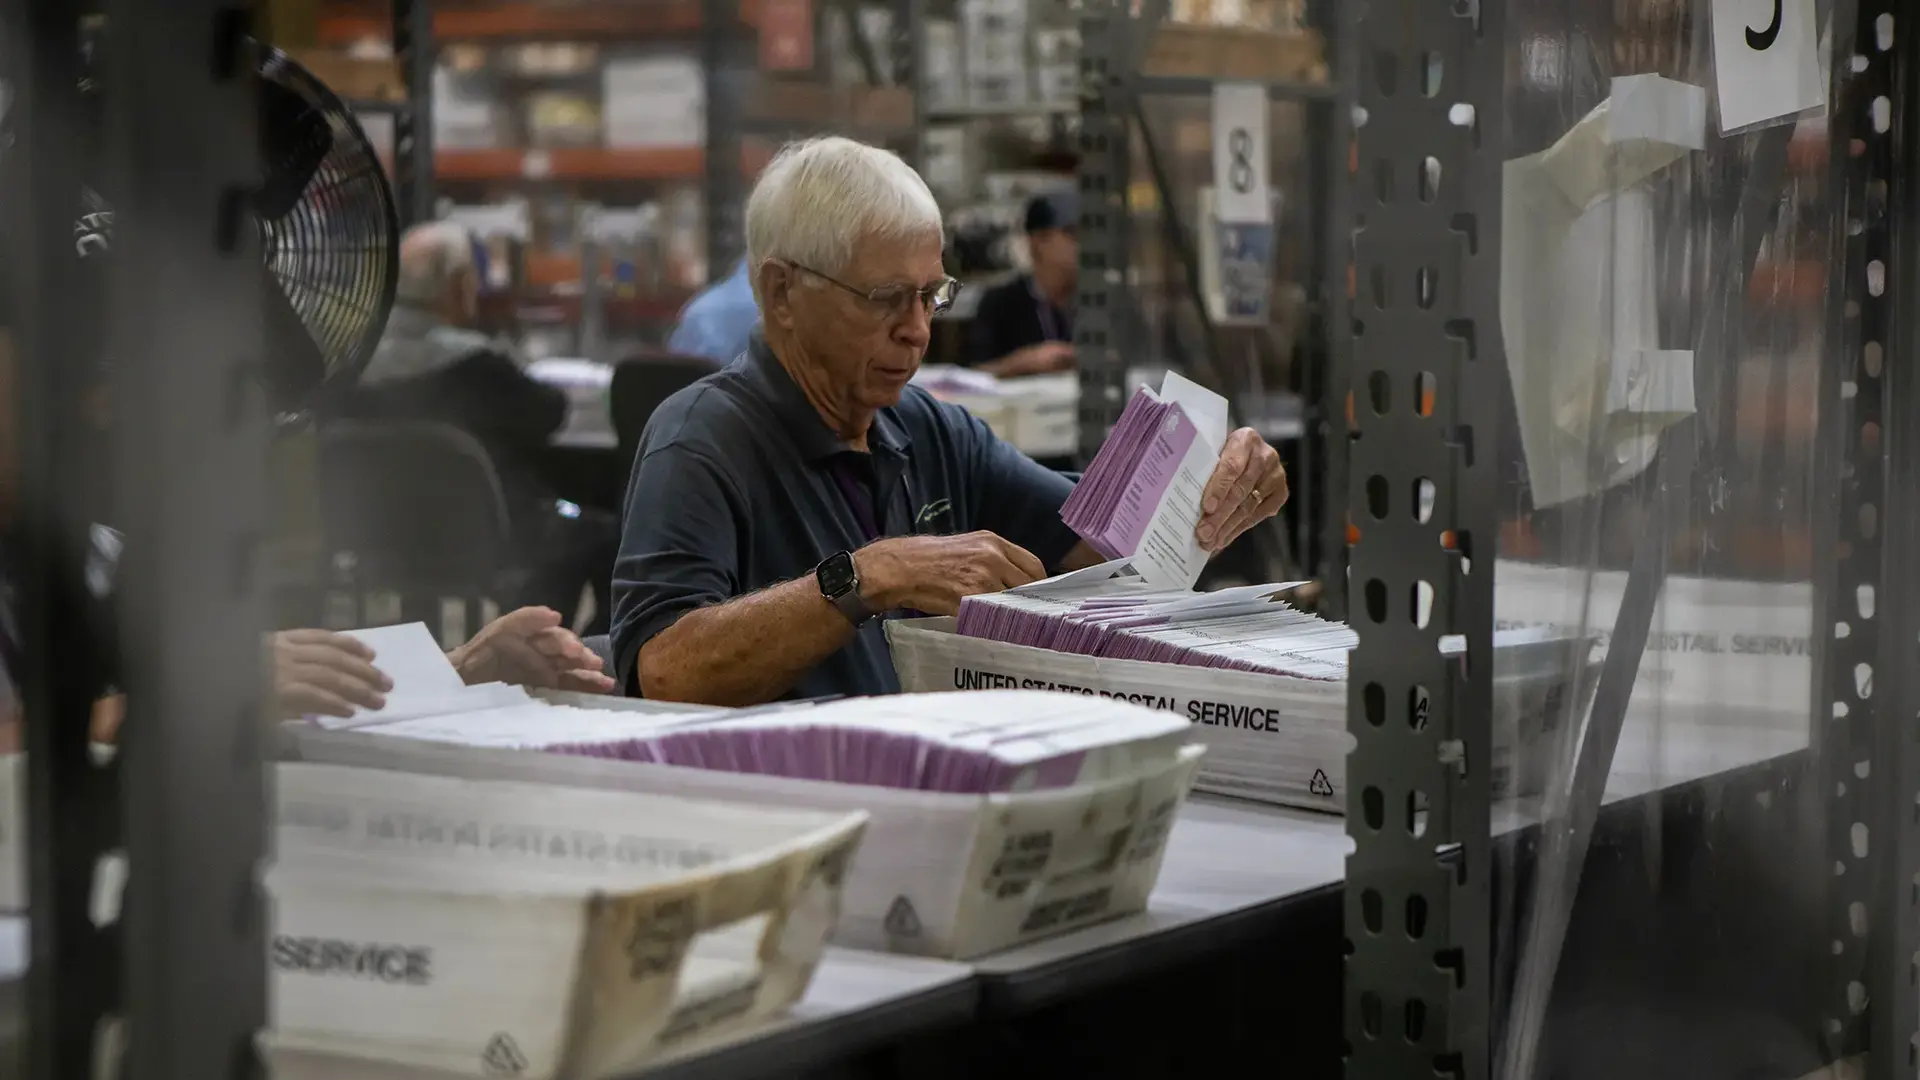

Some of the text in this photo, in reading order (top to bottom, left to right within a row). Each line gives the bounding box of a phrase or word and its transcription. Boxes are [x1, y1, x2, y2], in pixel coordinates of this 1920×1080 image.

[1228, 126, 1254, 194] 8
[1186, 699, 1280, 733] SERVICE
[272, 934, 435, 987] SERVICE
